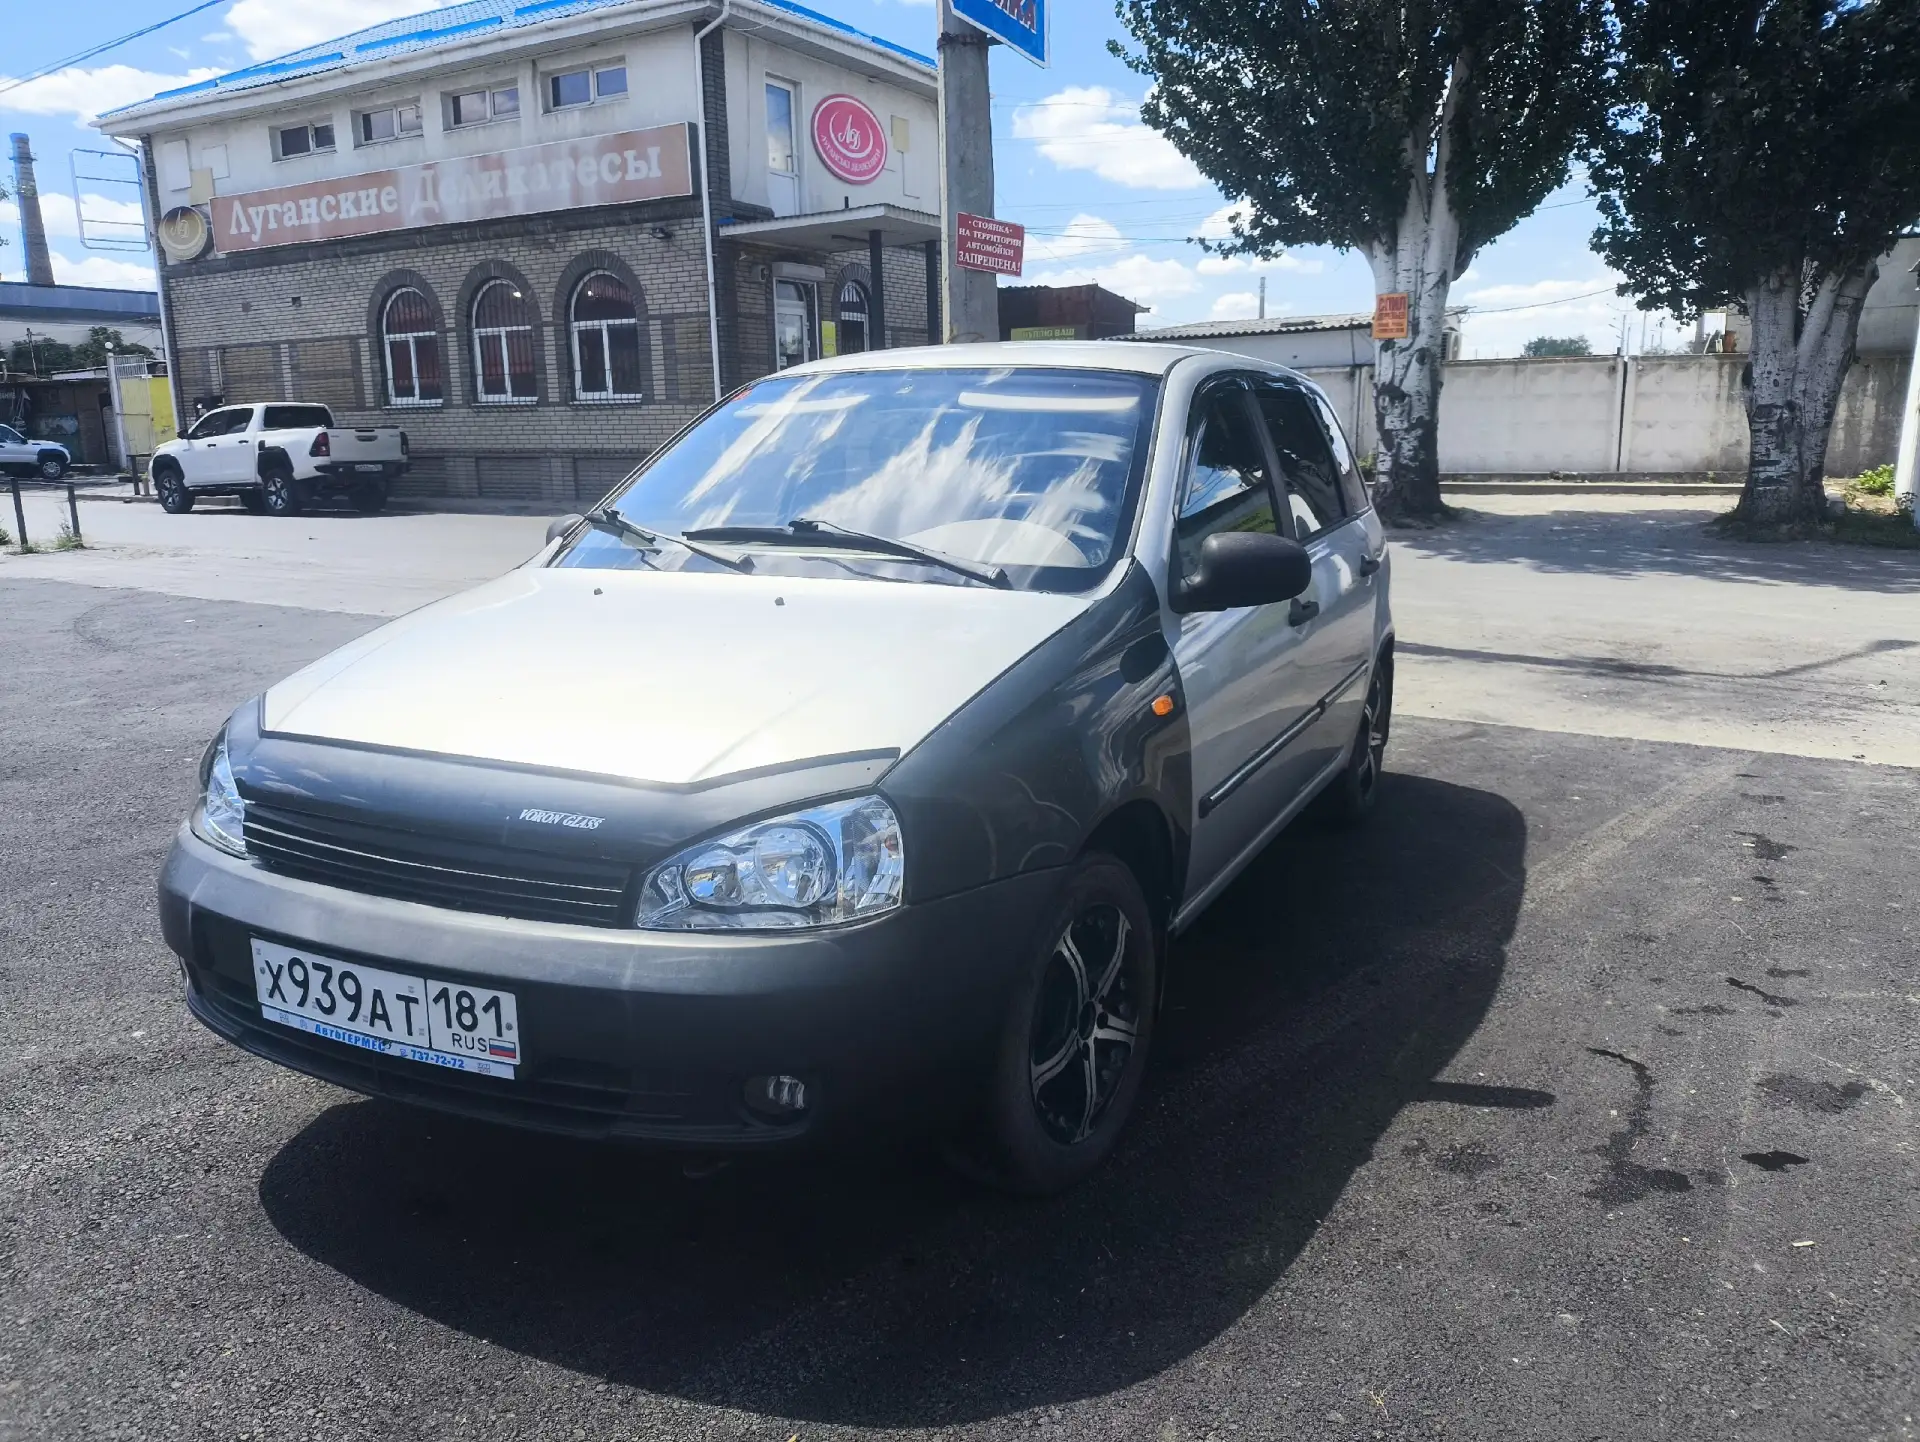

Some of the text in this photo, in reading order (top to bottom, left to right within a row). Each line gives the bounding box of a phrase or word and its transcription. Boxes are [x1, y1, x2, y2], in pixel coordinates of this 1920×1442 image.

[229, 147, 662, 242] Луганские Деликатесы
[959, 228, 971, 237] НА
[972, 220, 1010, 234] СТОЯНКА
[966, 241, 1014, 257] АВТОМОЙКИ
[958, 251, 1021, 273] ЗАПРЕЩЕНА!
[519, 808, 605, 830] VORON GLASS
[432, 986, 503, 1038] 181
[451, 1032, 488, 1053] RUS
[410, 1049, 465, 1069] 737-72-72
